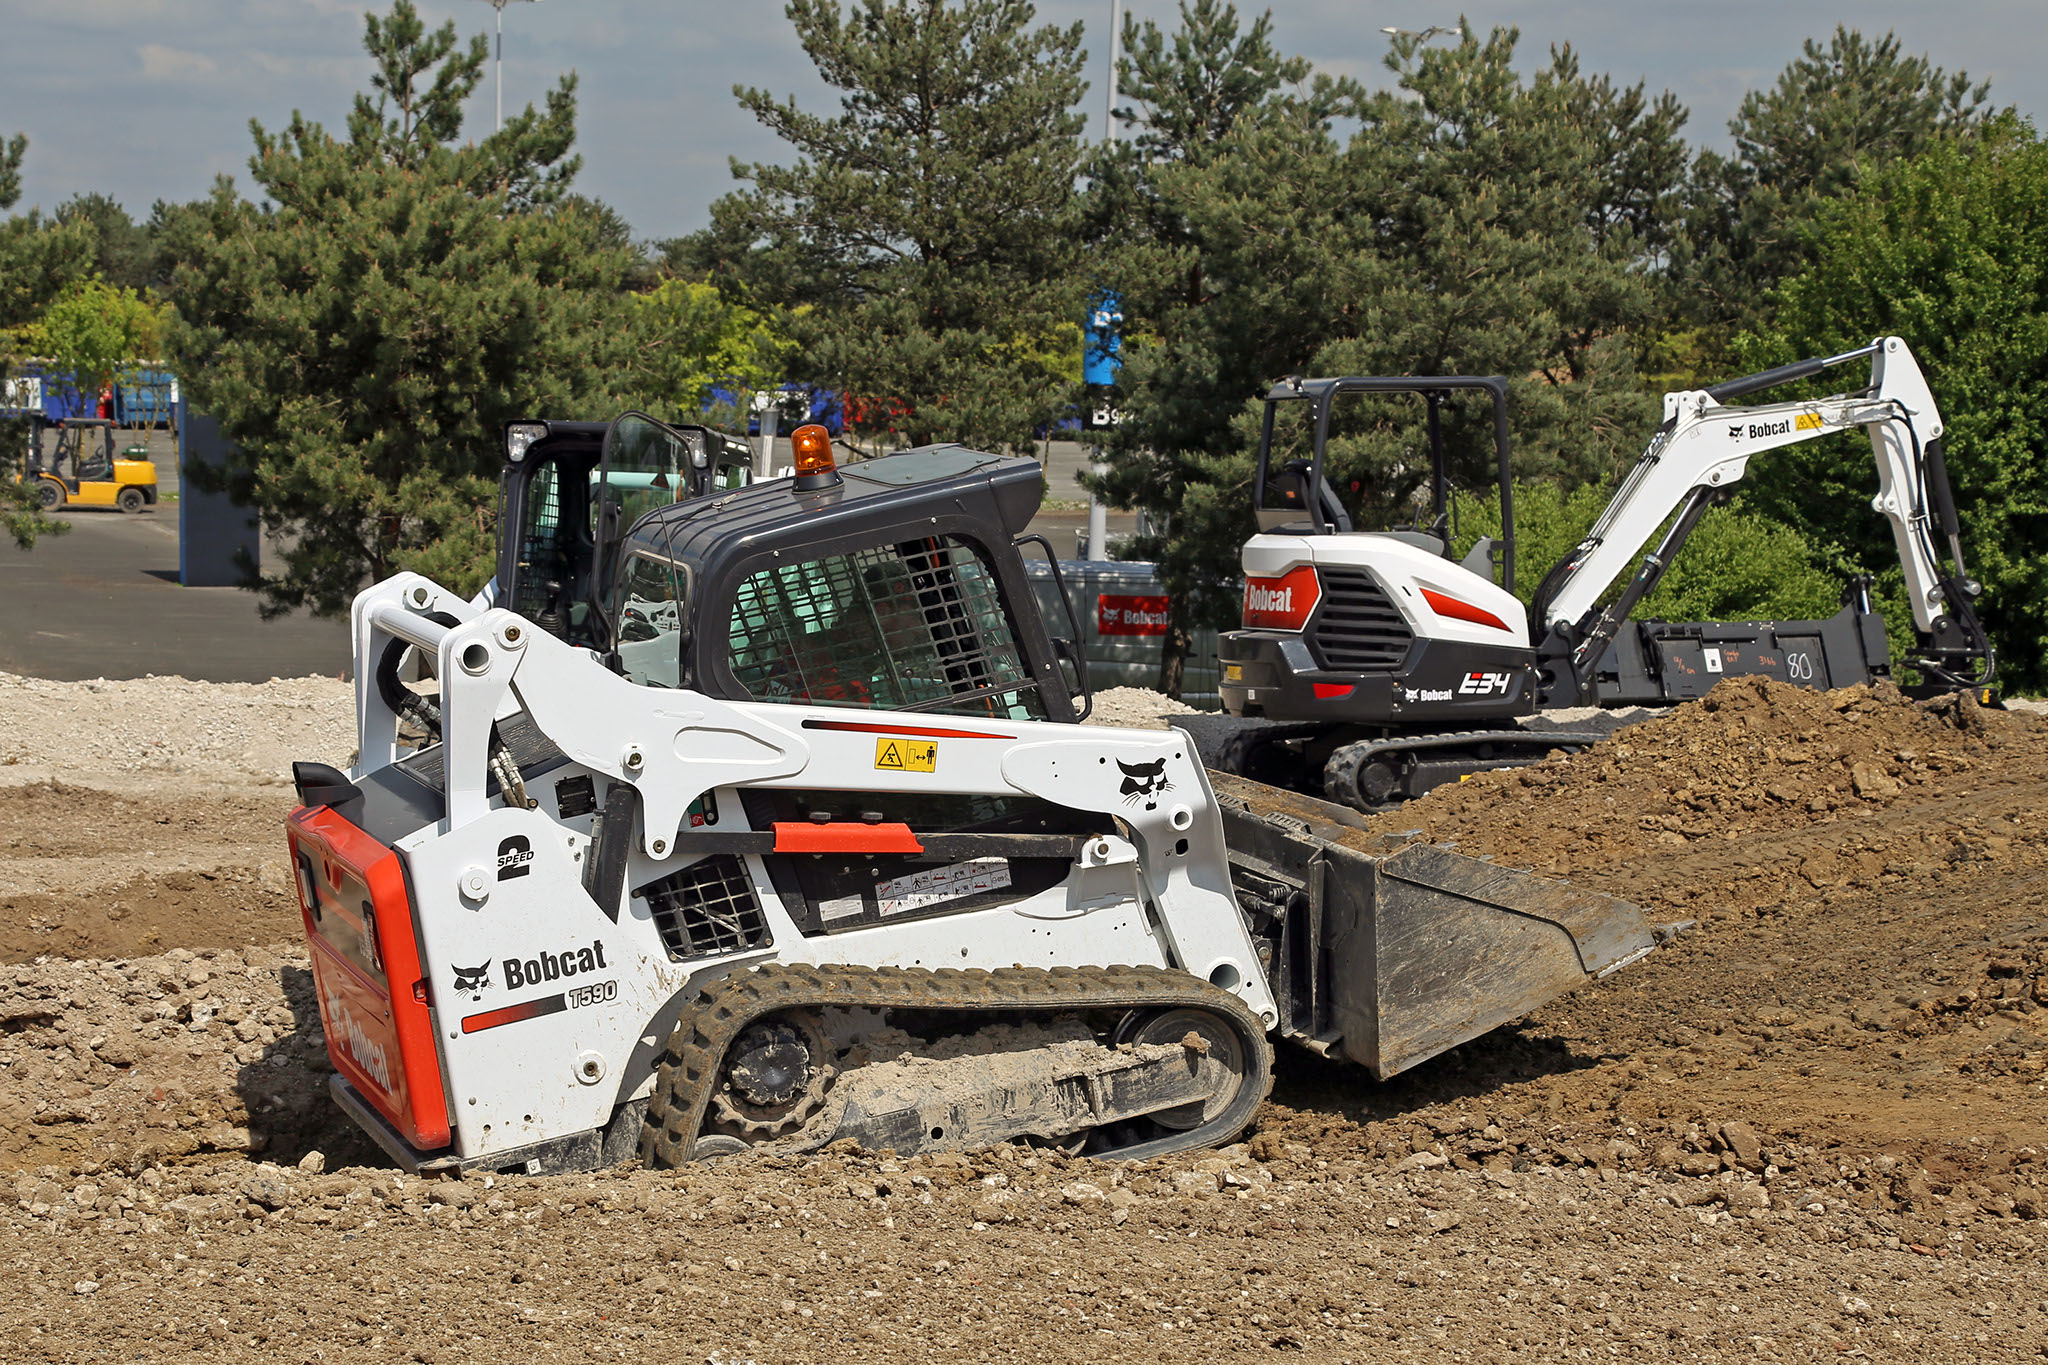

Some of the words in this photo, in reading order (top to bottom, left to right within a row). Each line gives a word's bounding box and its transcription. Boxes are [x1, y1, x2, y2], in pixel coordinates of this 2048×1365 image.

[1749, 419, 1791, 439] Bobcat
[1249, 585, 1292, 612] Bobcat
[1124, 610, 1168, 625] Bobcat
[1787, 652, 1813, 680] 80
[1420, 689, 1453, 701] Bobcat
[1458, 673, 1511, 694] E34
[497, 834, 531, 882] 2
[497, 850, 535, 867] SPEED
[502, 939, 607, 990] Bobcat
[569, 980, 618, 1009] T590
[343, 1007, 393, 1097] Bobcat
